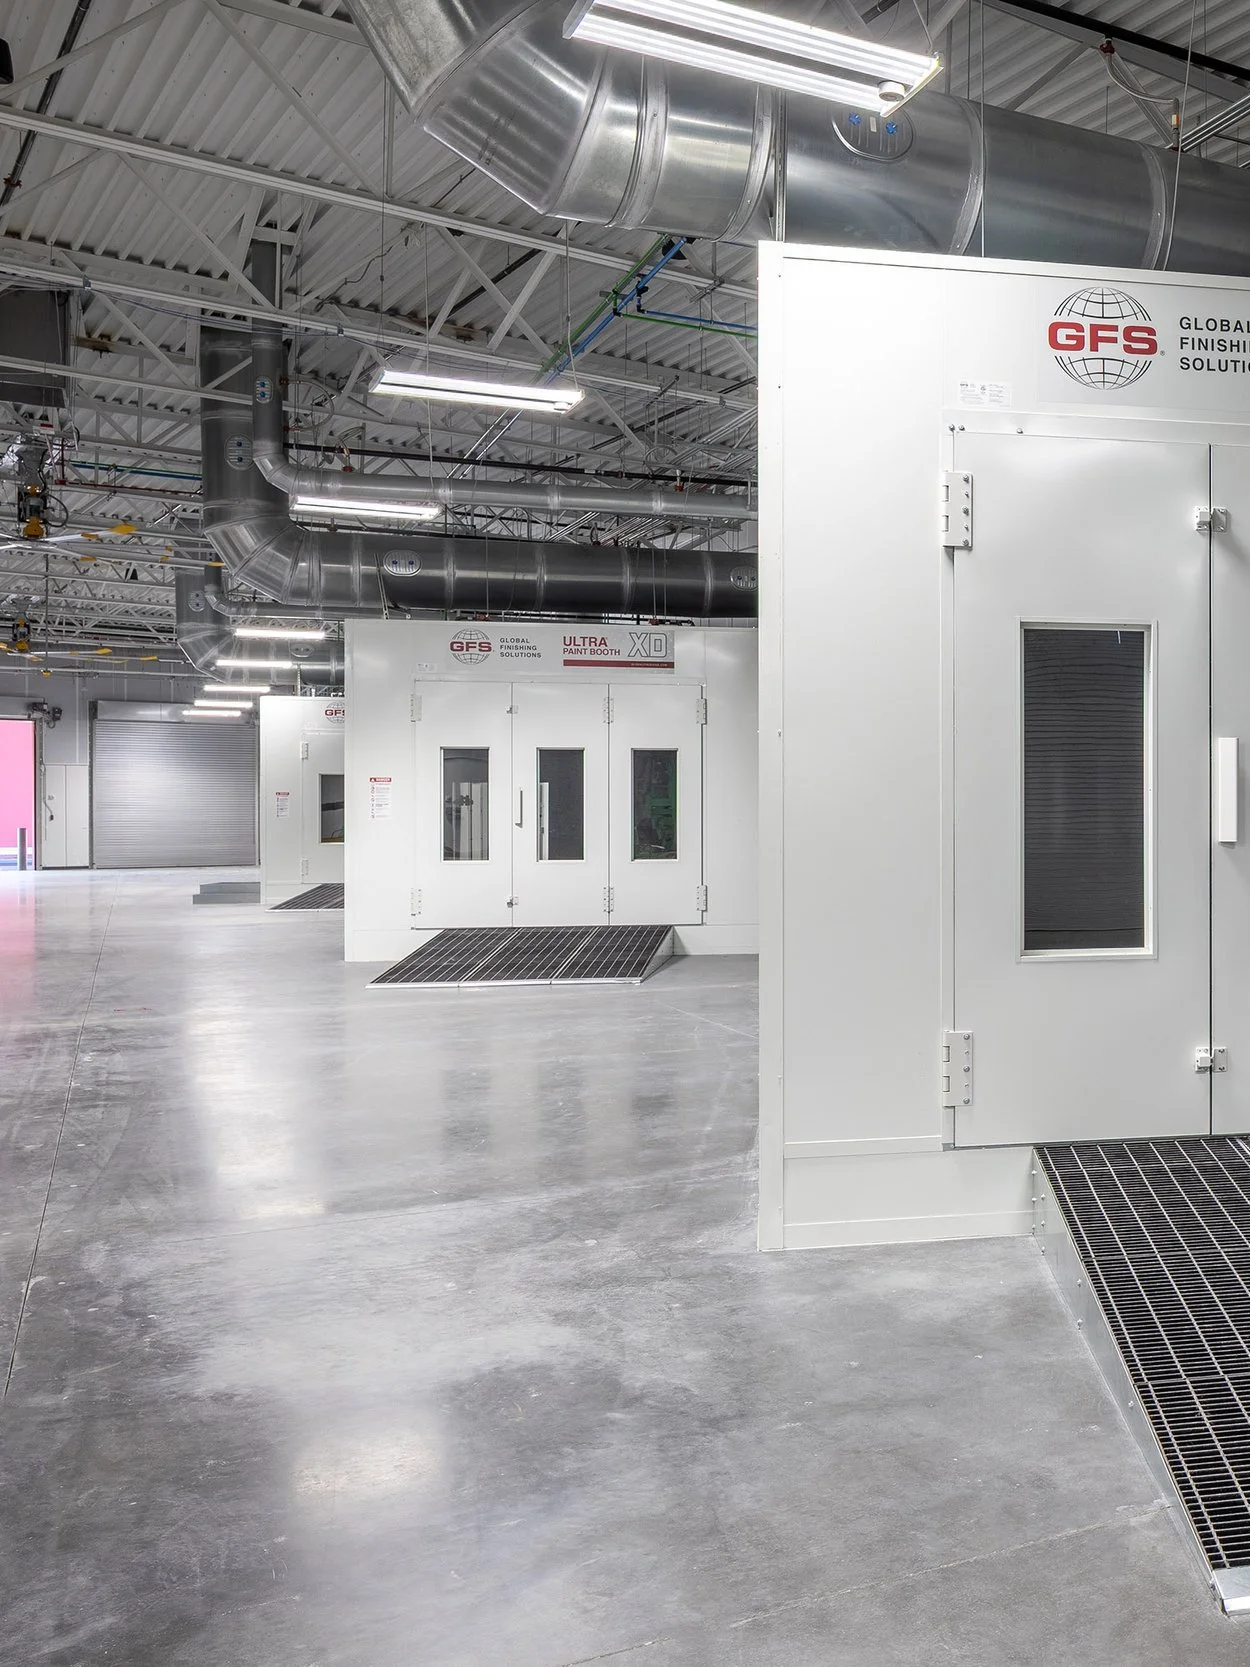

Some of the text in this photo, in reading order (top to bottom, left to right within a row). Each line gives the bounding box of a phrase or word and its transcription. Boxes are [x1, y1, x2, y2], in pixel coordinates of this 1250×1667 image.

[1048, 321, 1158, 356] GFS
[449, 640, 492, 652] GFS
[563, 636, 608, 647] ULTRA
[627, 632, 668, 658] XD
[563, 648, 621, 656] PAINT BOOTH
